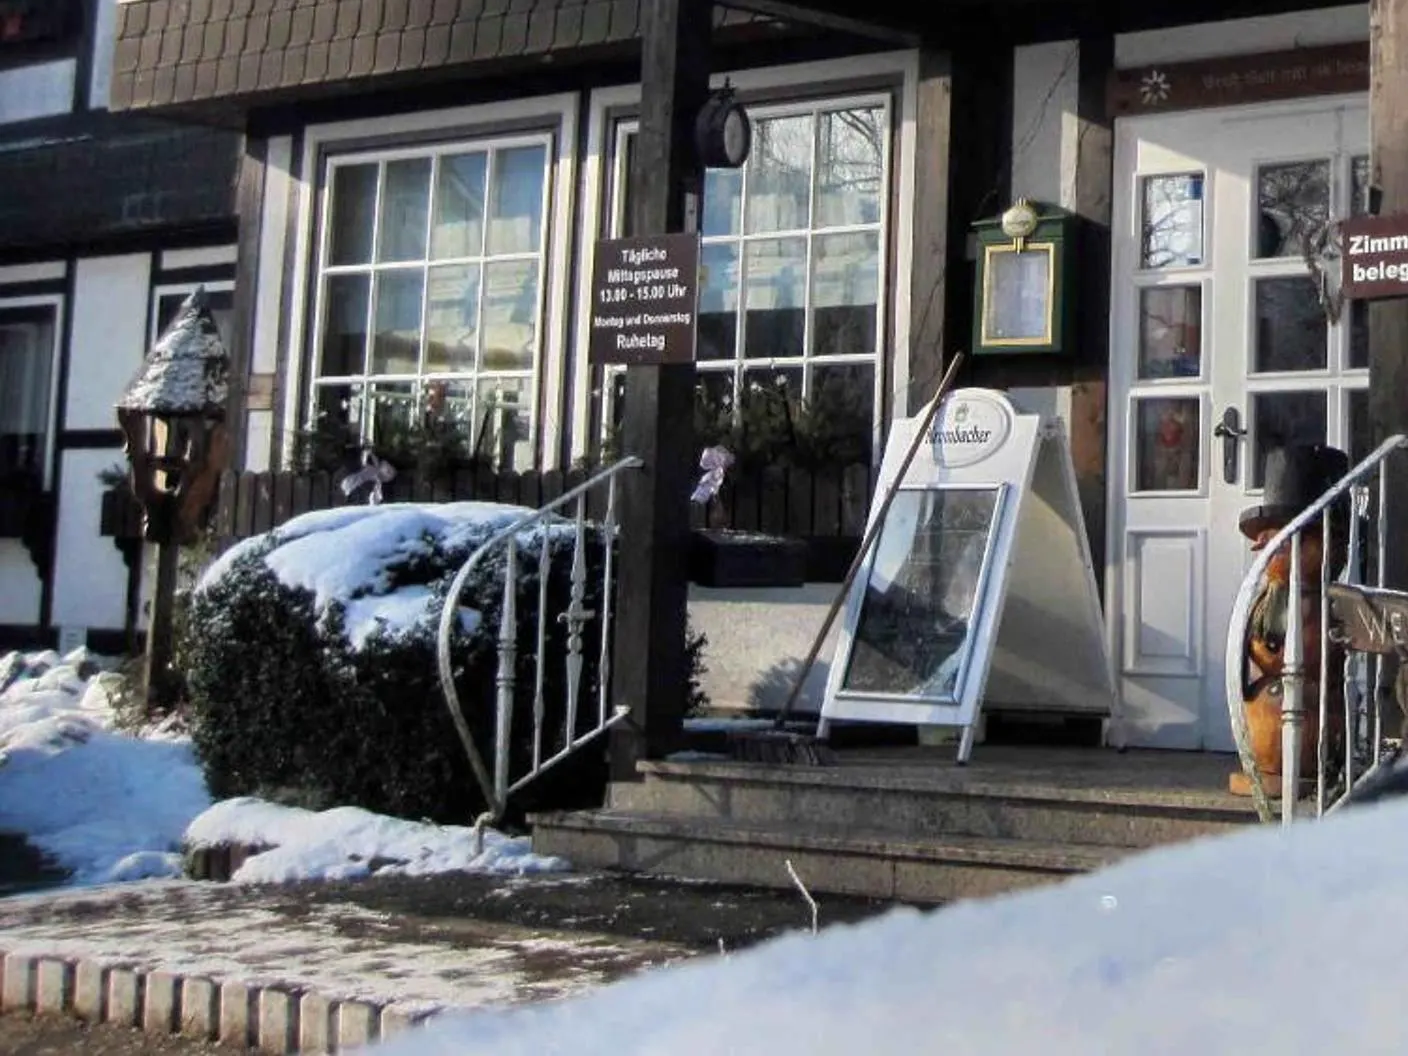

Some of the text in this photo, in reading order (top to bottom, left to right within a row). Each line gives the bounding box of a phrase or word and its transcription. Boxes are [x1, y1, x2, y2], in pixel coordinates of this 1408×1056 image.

[621, 248, 667, 265] Tägliche
[607, 267, 679, 285] Mittagspause
[637, 285, 665, 300] 15.00
[667, 283, 687, 298] Uhr
[617, 332, 665, 351] Ruhetag
